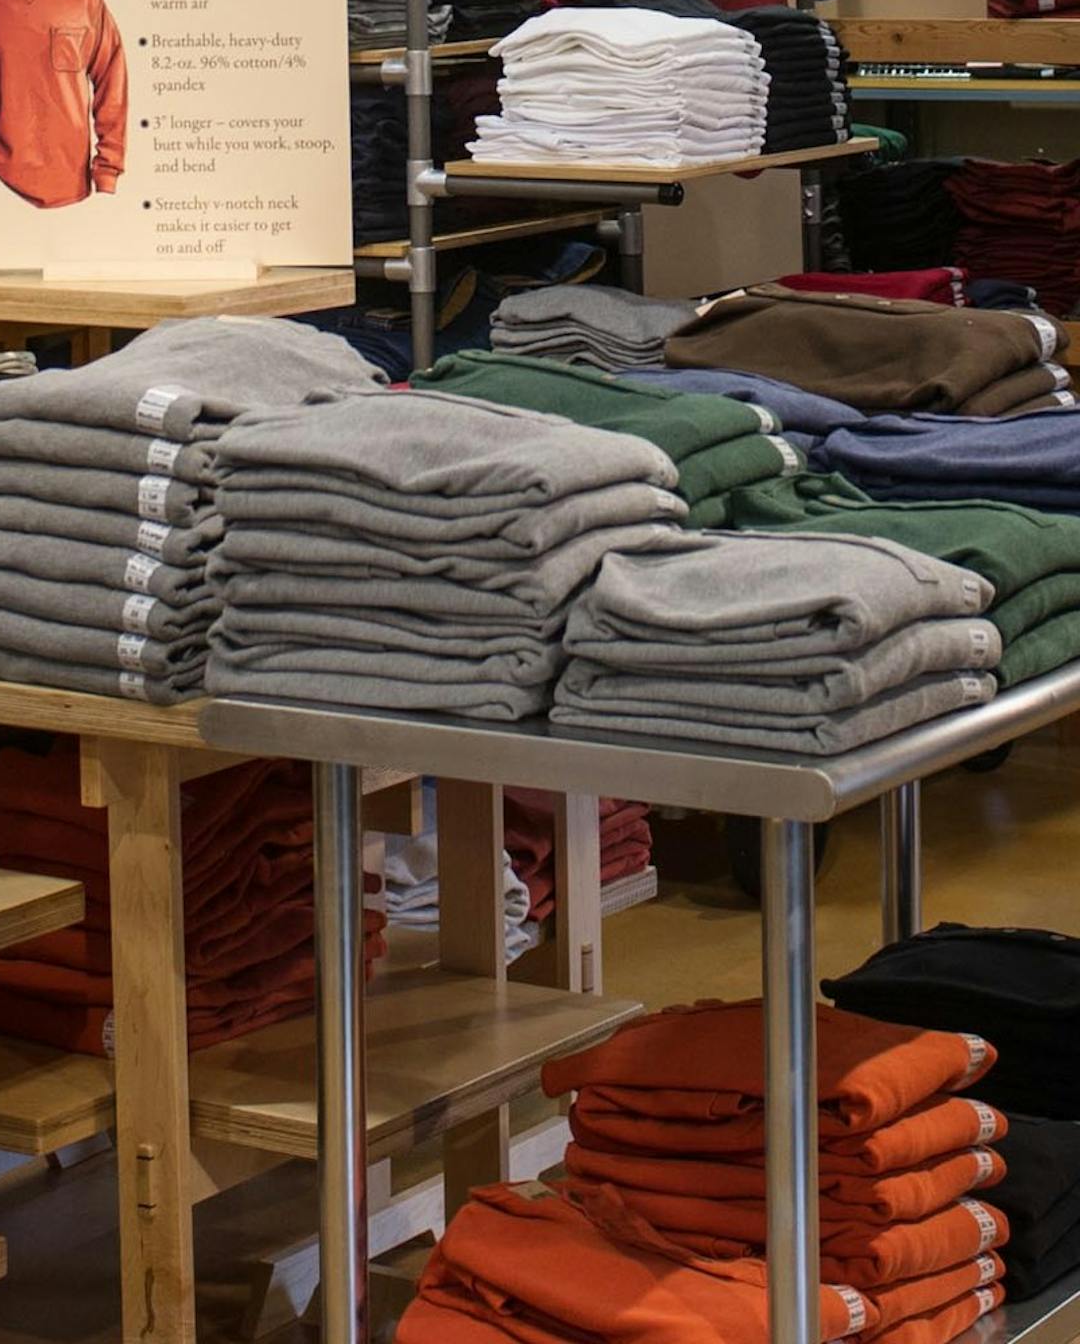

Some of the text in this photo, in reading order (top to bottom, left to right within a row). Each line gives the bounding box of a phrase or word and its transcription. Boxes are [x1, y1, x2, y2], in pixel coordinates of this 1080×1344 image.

[150, 0, 188, 10] warm
[152, 33, 302, 51] Breathable, heavy-duty
[200, 55, 230, 69] 96%
[233, 54, 307, 69] cotton/4%
[152, 77, 206, 96] spandex
[170, 115, 212, 134] longer
[229, 118, 270, 129] covers
[274, 117, 303, 132] your
[153, 136, 335, 154] butt while you work, stoop,
[154, 158, 216, 173] and bend
[155, 195, 299, 214] Stretchy v-notch neck
[156, 219, 291, 235] makes it easier to get
[156, 239, 225, 255] on and off
